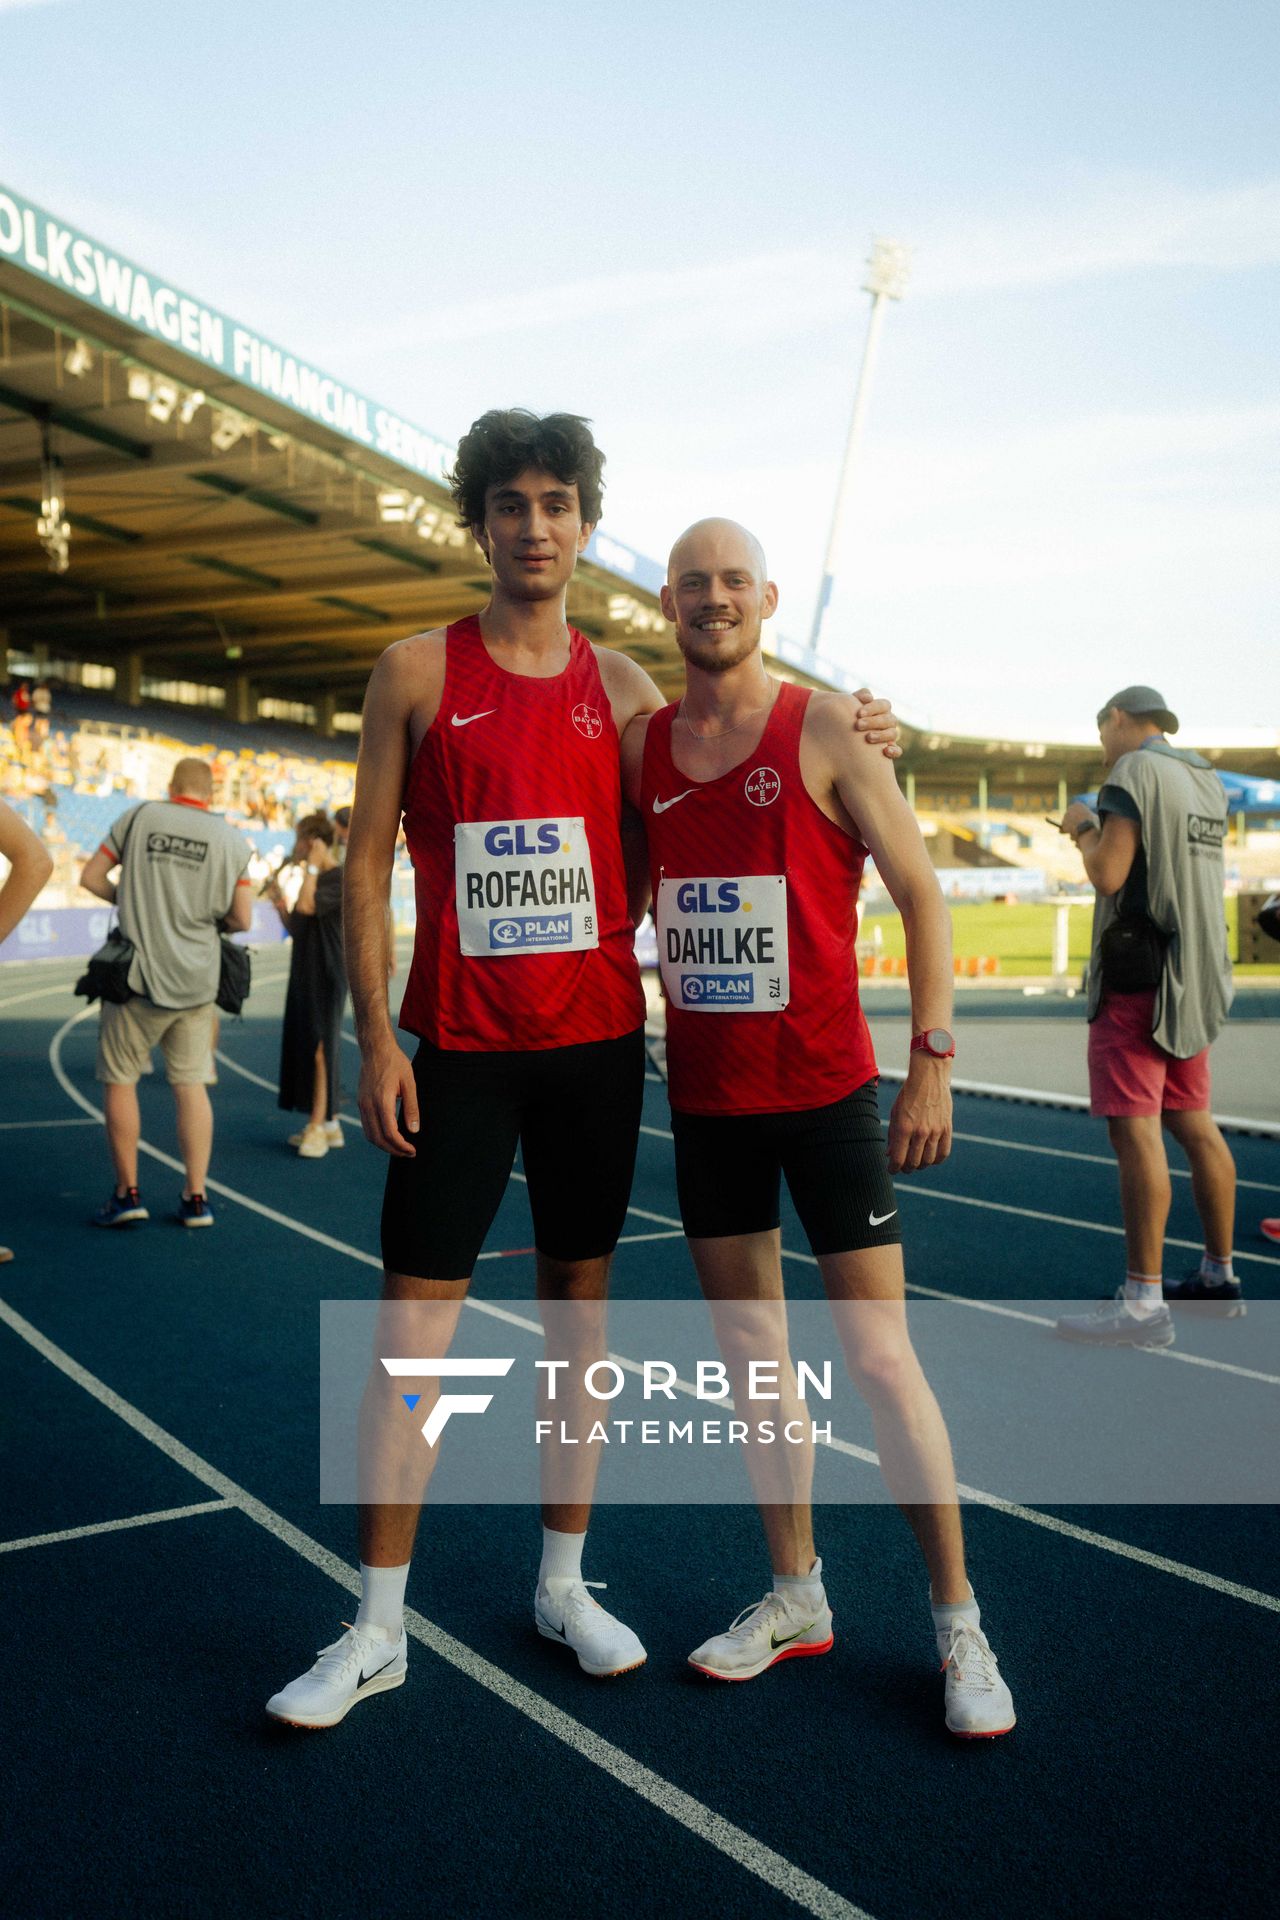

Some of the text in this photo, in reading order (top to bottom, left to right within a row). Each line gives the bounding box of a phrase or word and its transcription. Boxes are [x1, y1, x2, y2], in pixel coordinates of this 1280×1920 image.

[233, 328, 374, 446] FINANCIAL
[747, 781, 778, 793] BAYER
[171, 838, 206, 857] PLAN
[466, 867, 591, 910] ROFAGHA
[525, 919, 569, 935] PLAN
[584, 916, 593, 935] 821
[525, 934, 569, 943] INTERNATIONAL
[666, 927, 775, 965] DAHLKE
[706, 979, 750, 994] PLAN
[769, 977, 781, 998] 773
